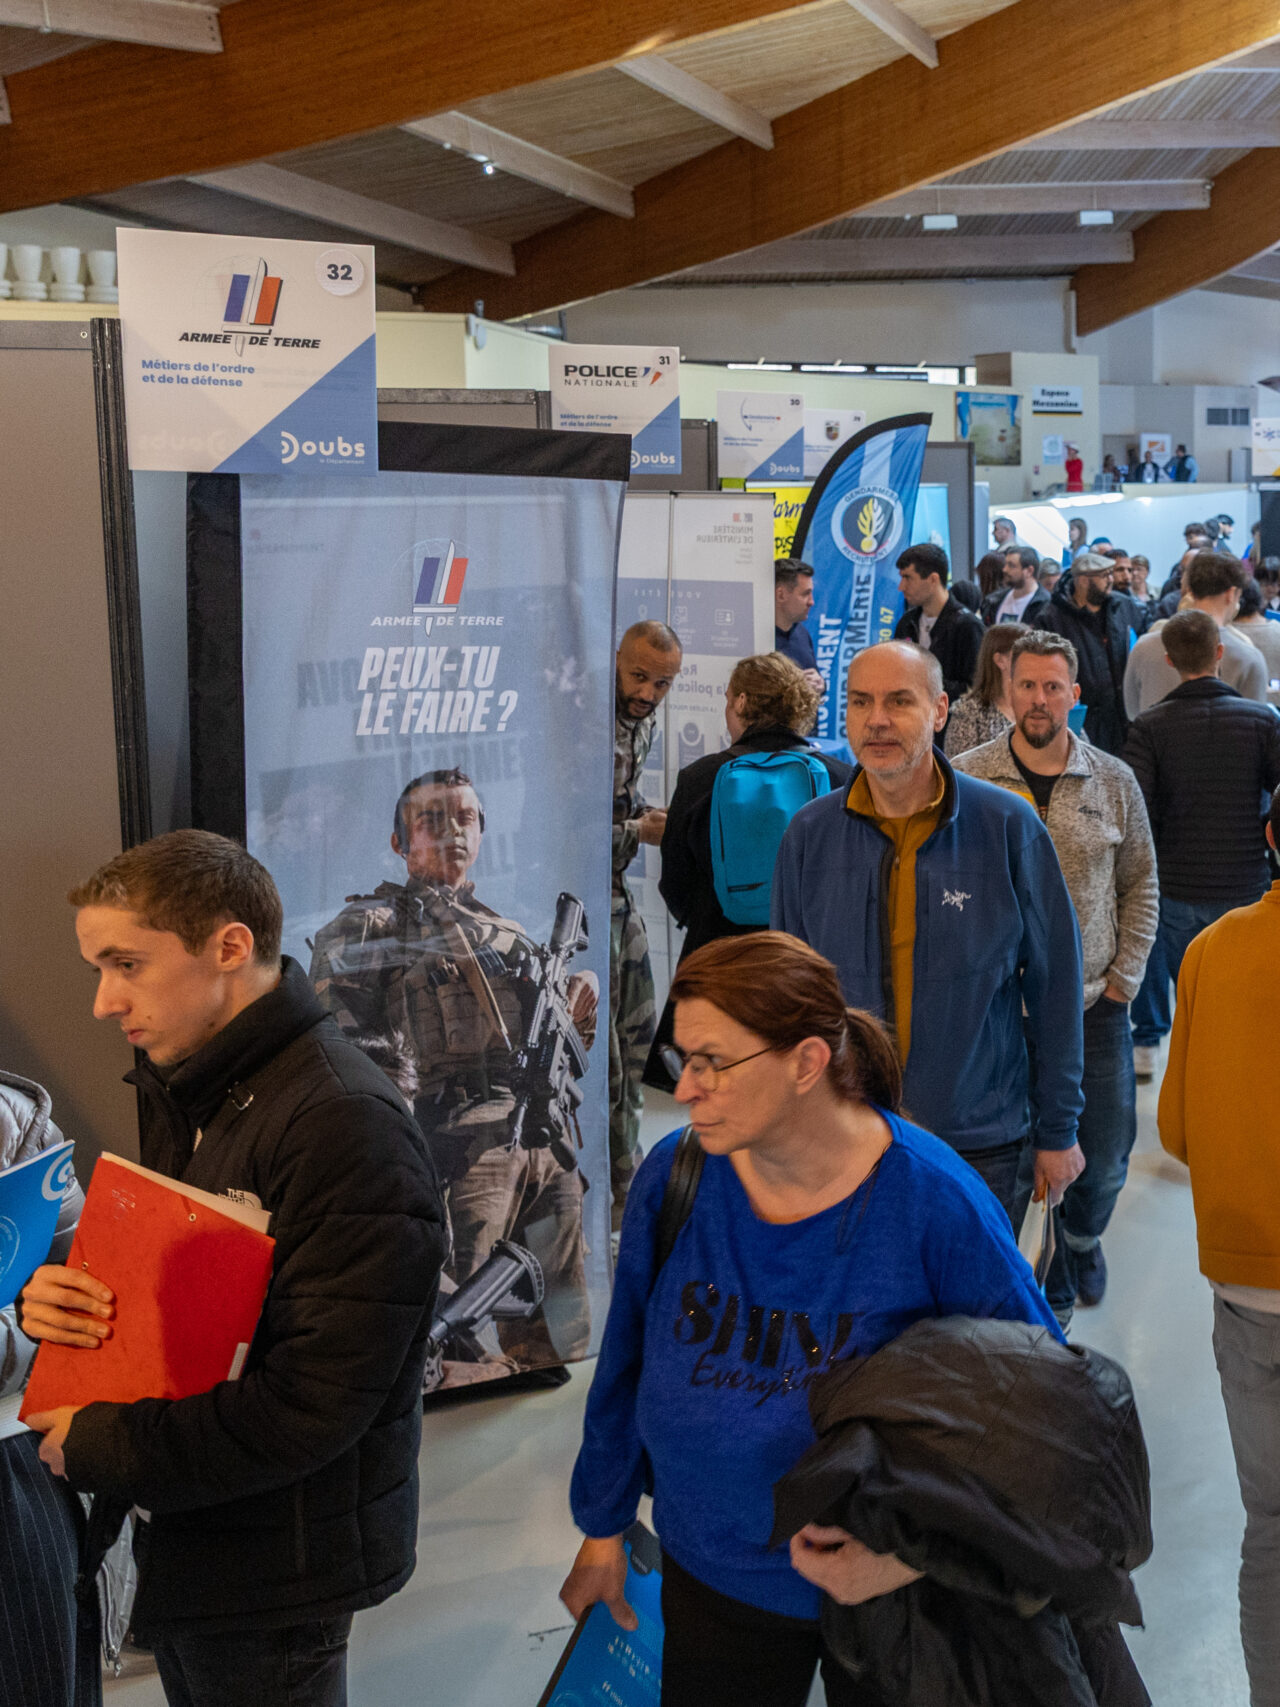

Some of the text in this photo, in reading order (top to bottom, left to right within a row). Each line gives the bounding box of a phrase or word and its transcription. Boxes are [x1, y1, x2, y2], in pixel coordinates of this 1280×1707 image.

[326, 263, 354, 281] 32
[178, 332, 322, 349] ARMEE DE TERRE
[141, 358, 191, 371] Métiers
[193, 361, 210, 373] de
[658, 355, 671, 366] 31
[563, 364, 639, 379] POLICE
[141, 374, 244, 388] et de la défense
[564, 379, 638, 388] NATIONALE
[1040, 388, 1070, 399] Espace
[789, 398, 801, 406] 30
[280, 430, 366, 465] Doubs
[370, 616, 505, 627] ARMEE DE TERRE
[879, 606, 895, 625] 47
[357, 645, 502, 692] PEUX-TU
[355, 689, 520, 737] LE FAIRE ?
